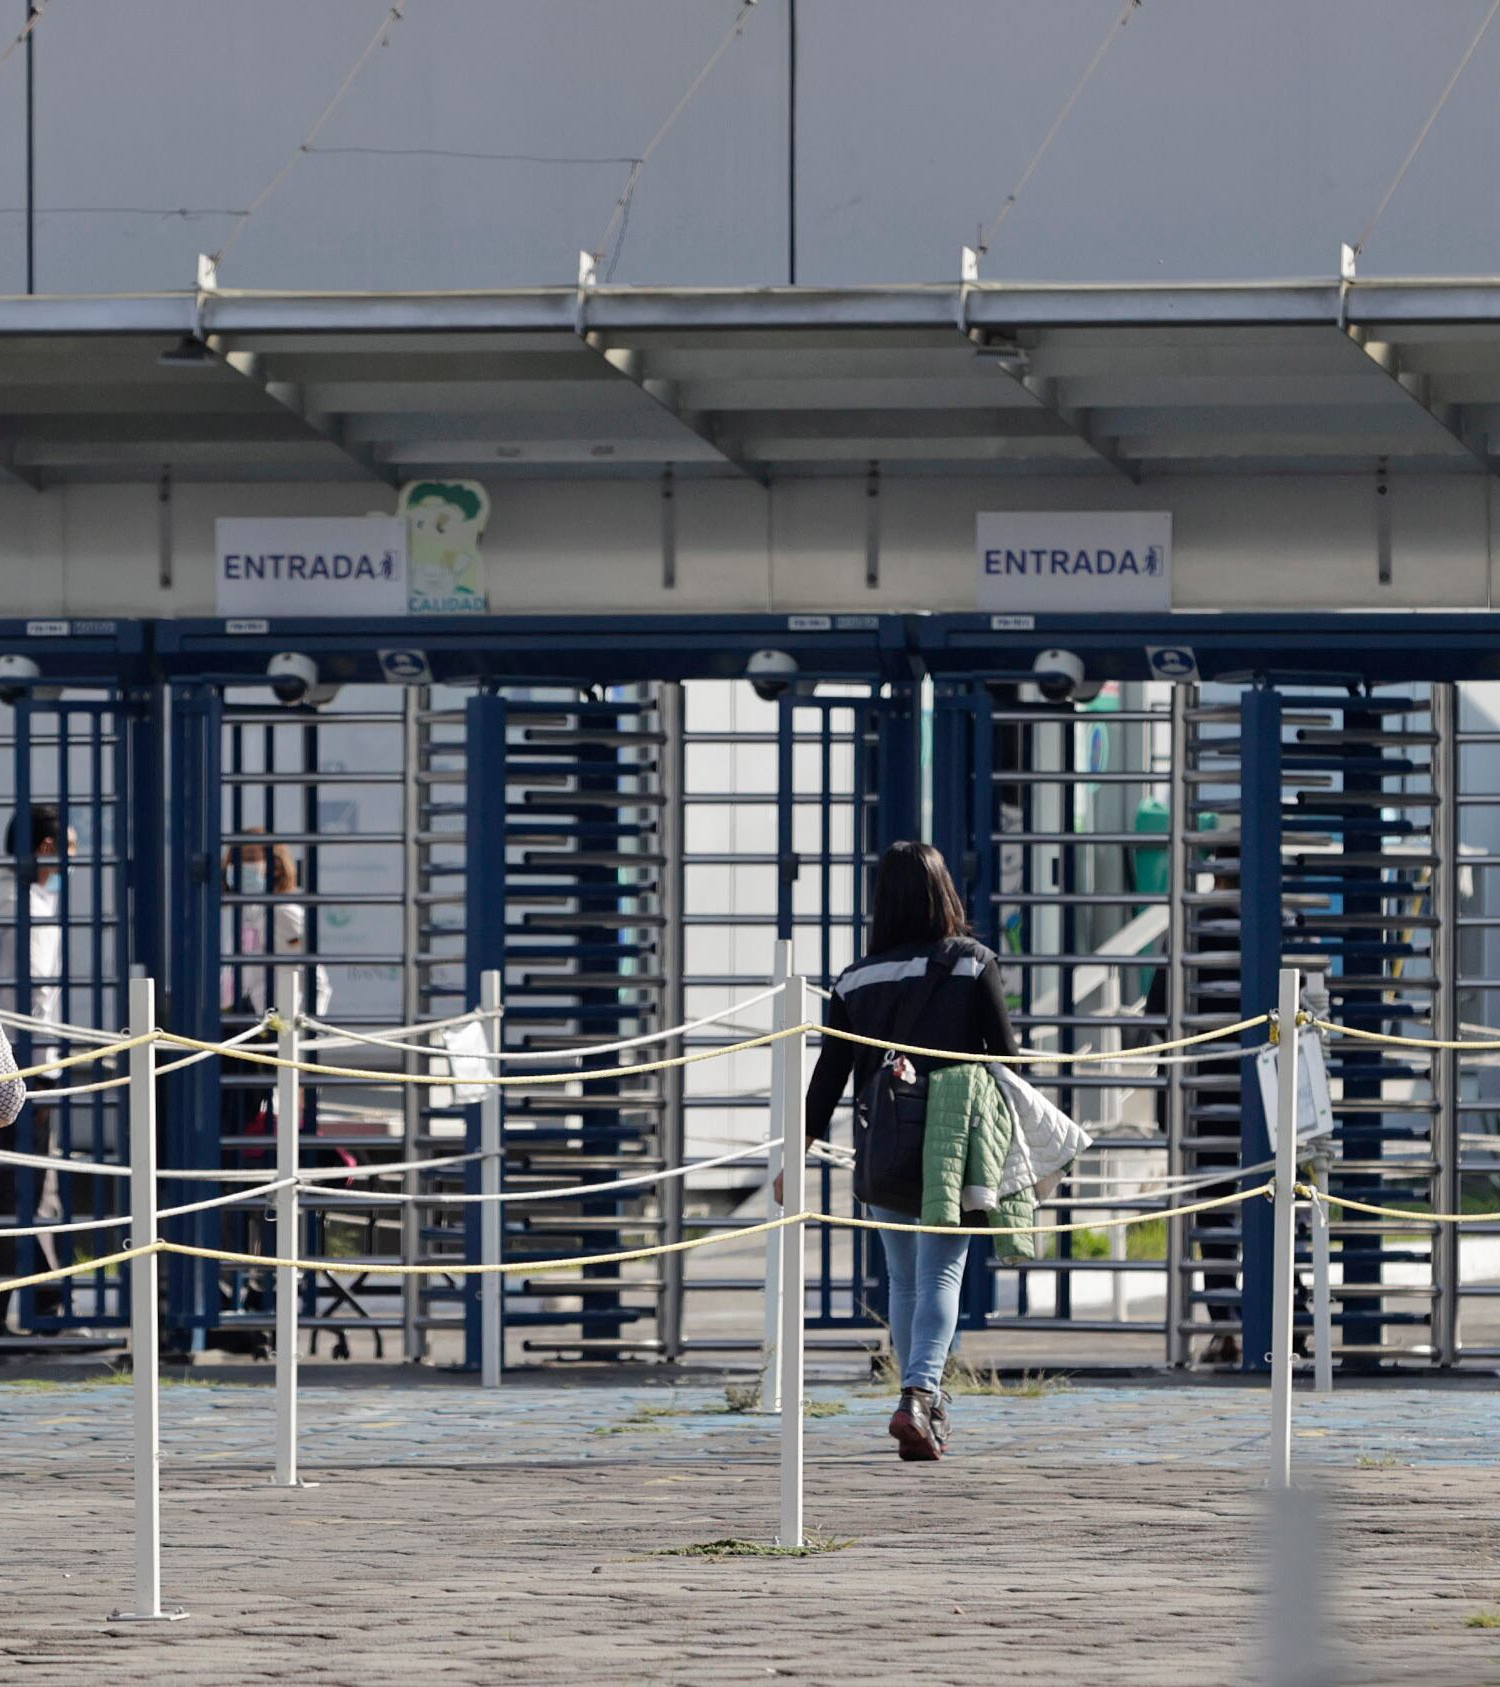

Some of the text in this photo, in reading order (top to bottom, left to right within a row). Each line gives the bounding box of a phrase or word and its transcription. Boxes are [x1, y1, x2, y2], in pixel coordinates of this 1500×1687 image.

[224, 554, 376, 580] ENTRADA
[984, 549, 1139, 575] ENTRADA
[408, 596, 486, 613] CALIDAD
